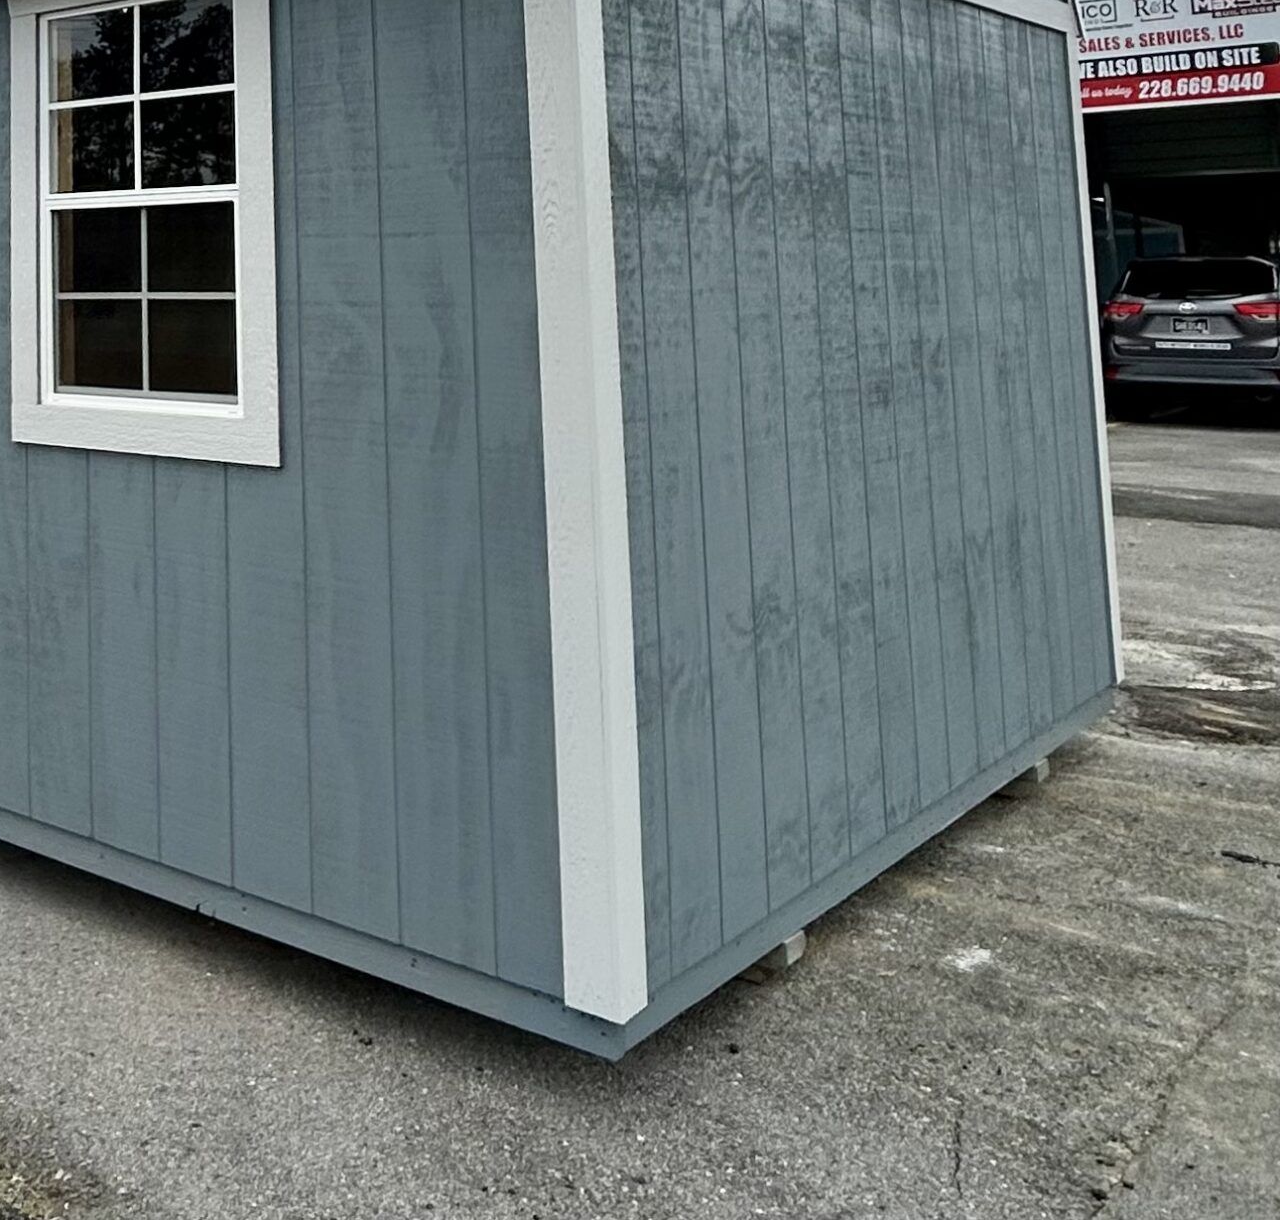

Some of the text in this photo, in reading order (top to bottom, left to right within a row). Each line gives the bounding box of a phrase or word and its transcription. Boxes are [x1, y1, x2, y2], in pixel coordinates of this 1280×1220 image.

[1079, 36, 1121, 53] SALES
[1125, 37, 1135, 49] &
[1218, 23, 1244, 40] LLC
[1098, 58, 1138, 78] ALSO
[1141, 53, 1192, 74] BUILD
[1194, 50, 1219, 70] ON
[1221, 47, 1261, 67] SITE
[1104, 84, 1133, 99] today
[1138, 71, 1265, 99] 228.669.9440
